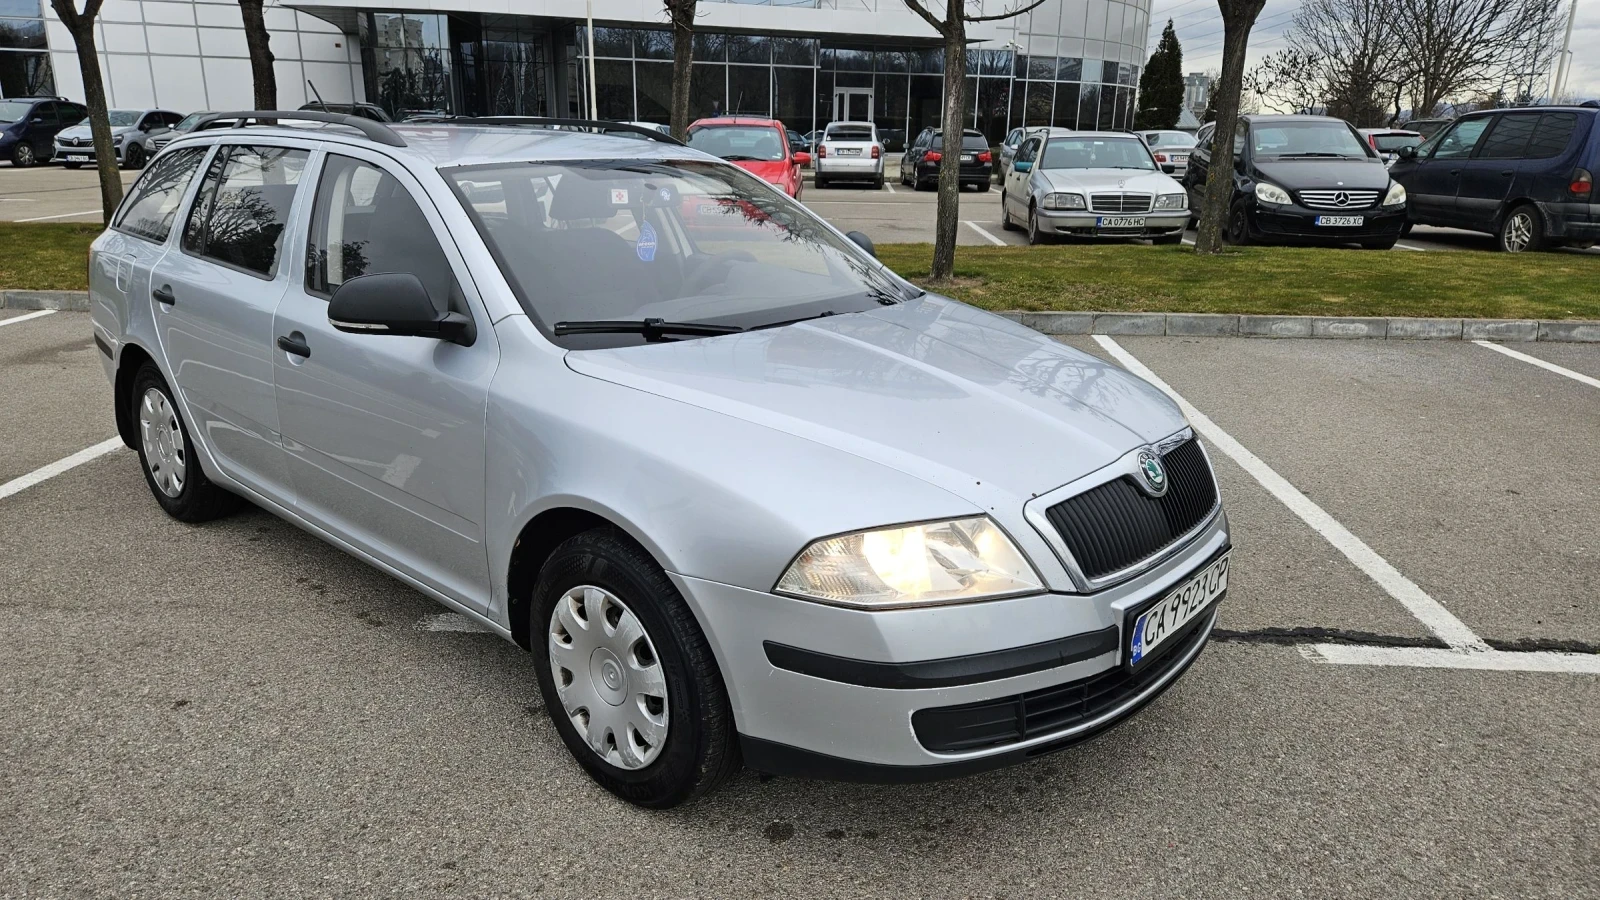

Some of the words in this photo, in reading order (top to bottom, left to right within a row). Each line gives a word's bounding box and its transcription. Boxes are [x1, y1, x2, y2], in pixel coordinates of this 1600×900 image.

[1102, 218, 1112, 226] CA
[1113, 218, 1132, 226] 0776
[1133, 218, 1144, 226] HC
[1320, 216, 1331, 225] CB
[1332, 217, 1351, 225] 3726
[1352, 217, 1362, 225] XC
[1145, 603, 1168, 646] CA
[1171, 573, 1208, 627] 9923
[1209, 556, 1229, 595] CP
